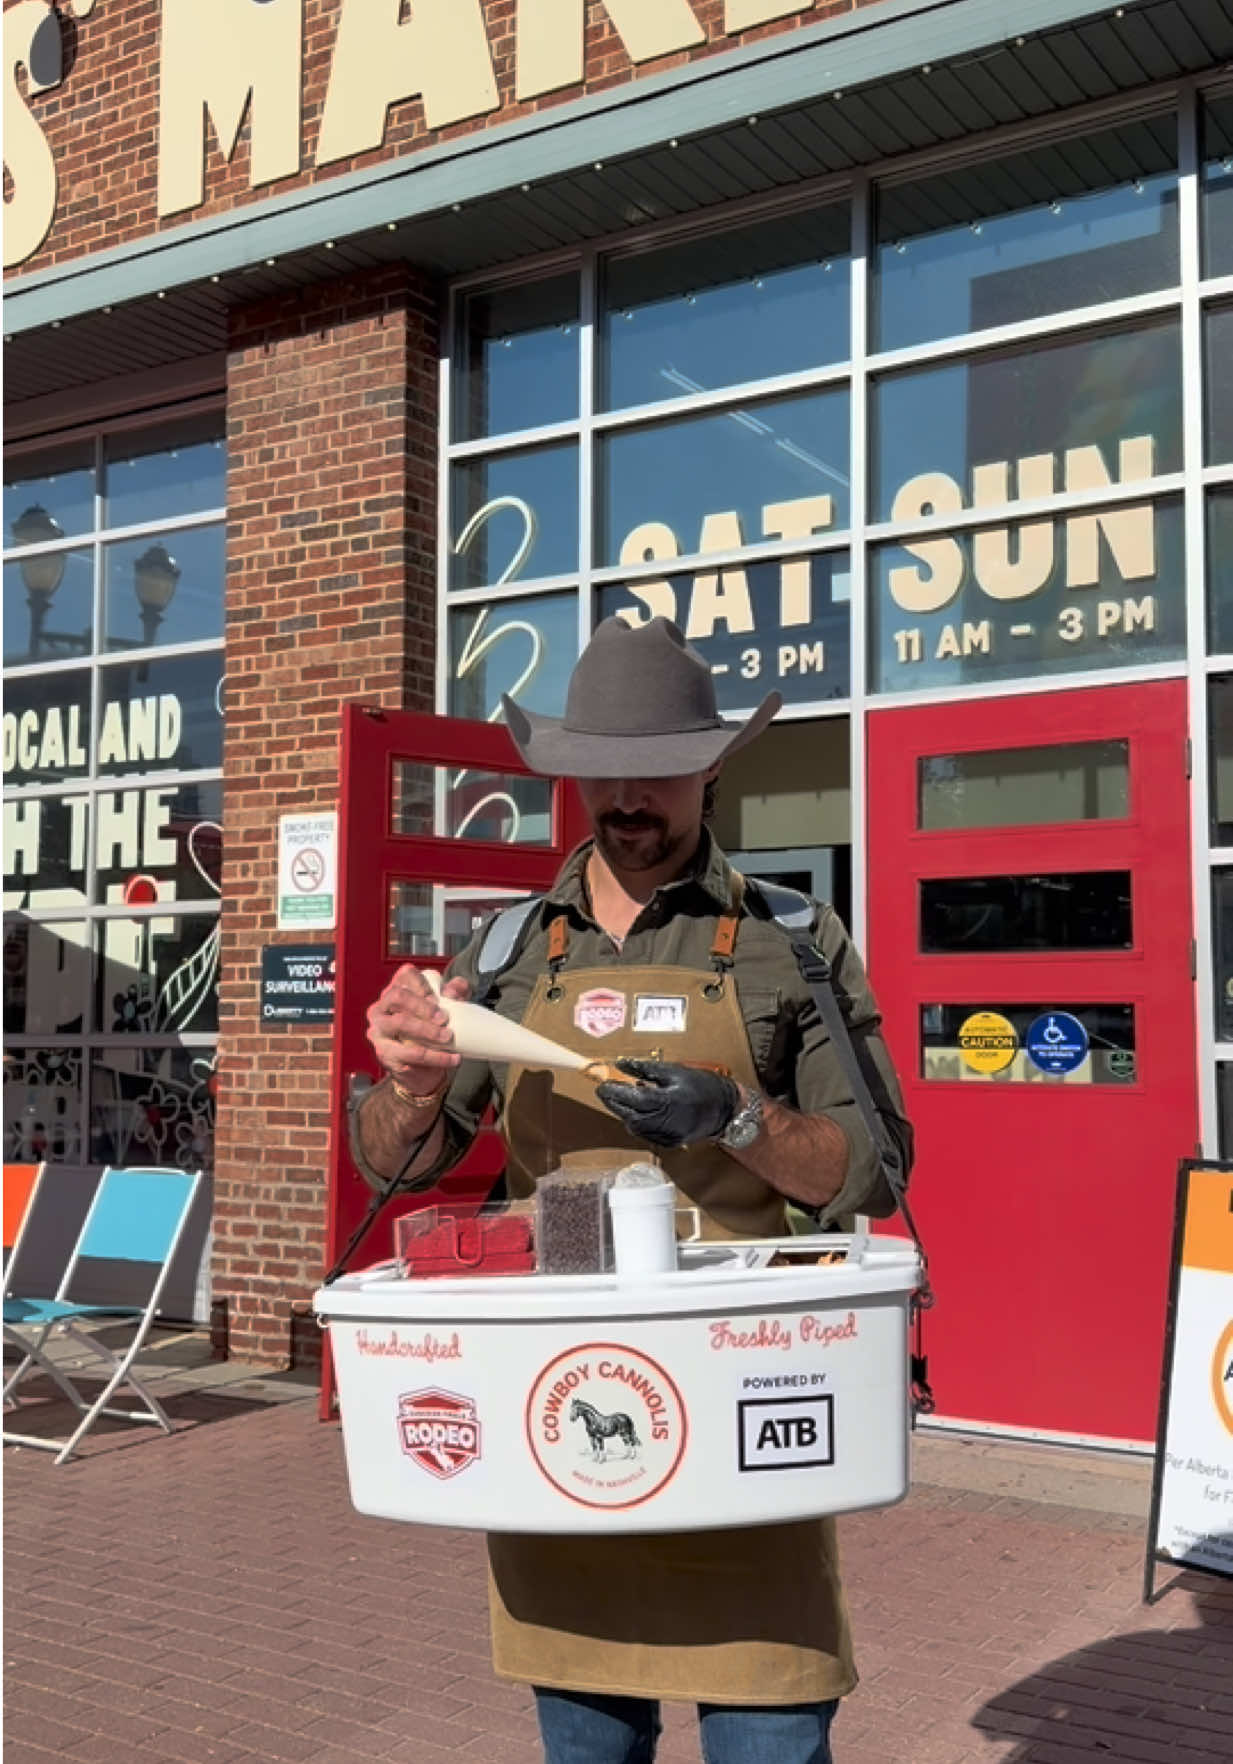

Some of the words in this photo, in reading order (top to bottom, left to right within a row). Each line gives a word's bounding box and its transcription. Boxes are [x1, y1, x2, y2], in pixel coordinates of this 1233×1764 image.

[888, 434, 1157, 613] SUN
[615, 494, 832, 639] SAT
[894, 628, 922, 662] 11
[935, 620, 991, 658] AM
[1058, 606, 1084, 641] 3
[1097, 596, 1155, 636] PM
[740, 648, 761, 678] 3
[778, 641, 824, 676] PM
[98, 694, 182, 764] AND
[61, 769, 179, 871] THE
[287, 964, 323, 977] VIDEO
[961, 1037, 1013, 1049] CAUTION
[355, 1329, 463, 1363] Handcrafted
[709, 1319, 792, 1350] Freshly
[800, 1312, 858, 1347] Piped
[742, 1375, 808, 1389] POWERED
[811, 1373, 826, 1384] BY
[542, 1363, 590, 1443] COWBOY
[598, 1360, 669, 1440] CANNOLIS
[404, 1423, 475, 1449] RODEO
[757, 1416, 818, 1450] ATB
[1186, 1457, 1229, 1480] Alberta
